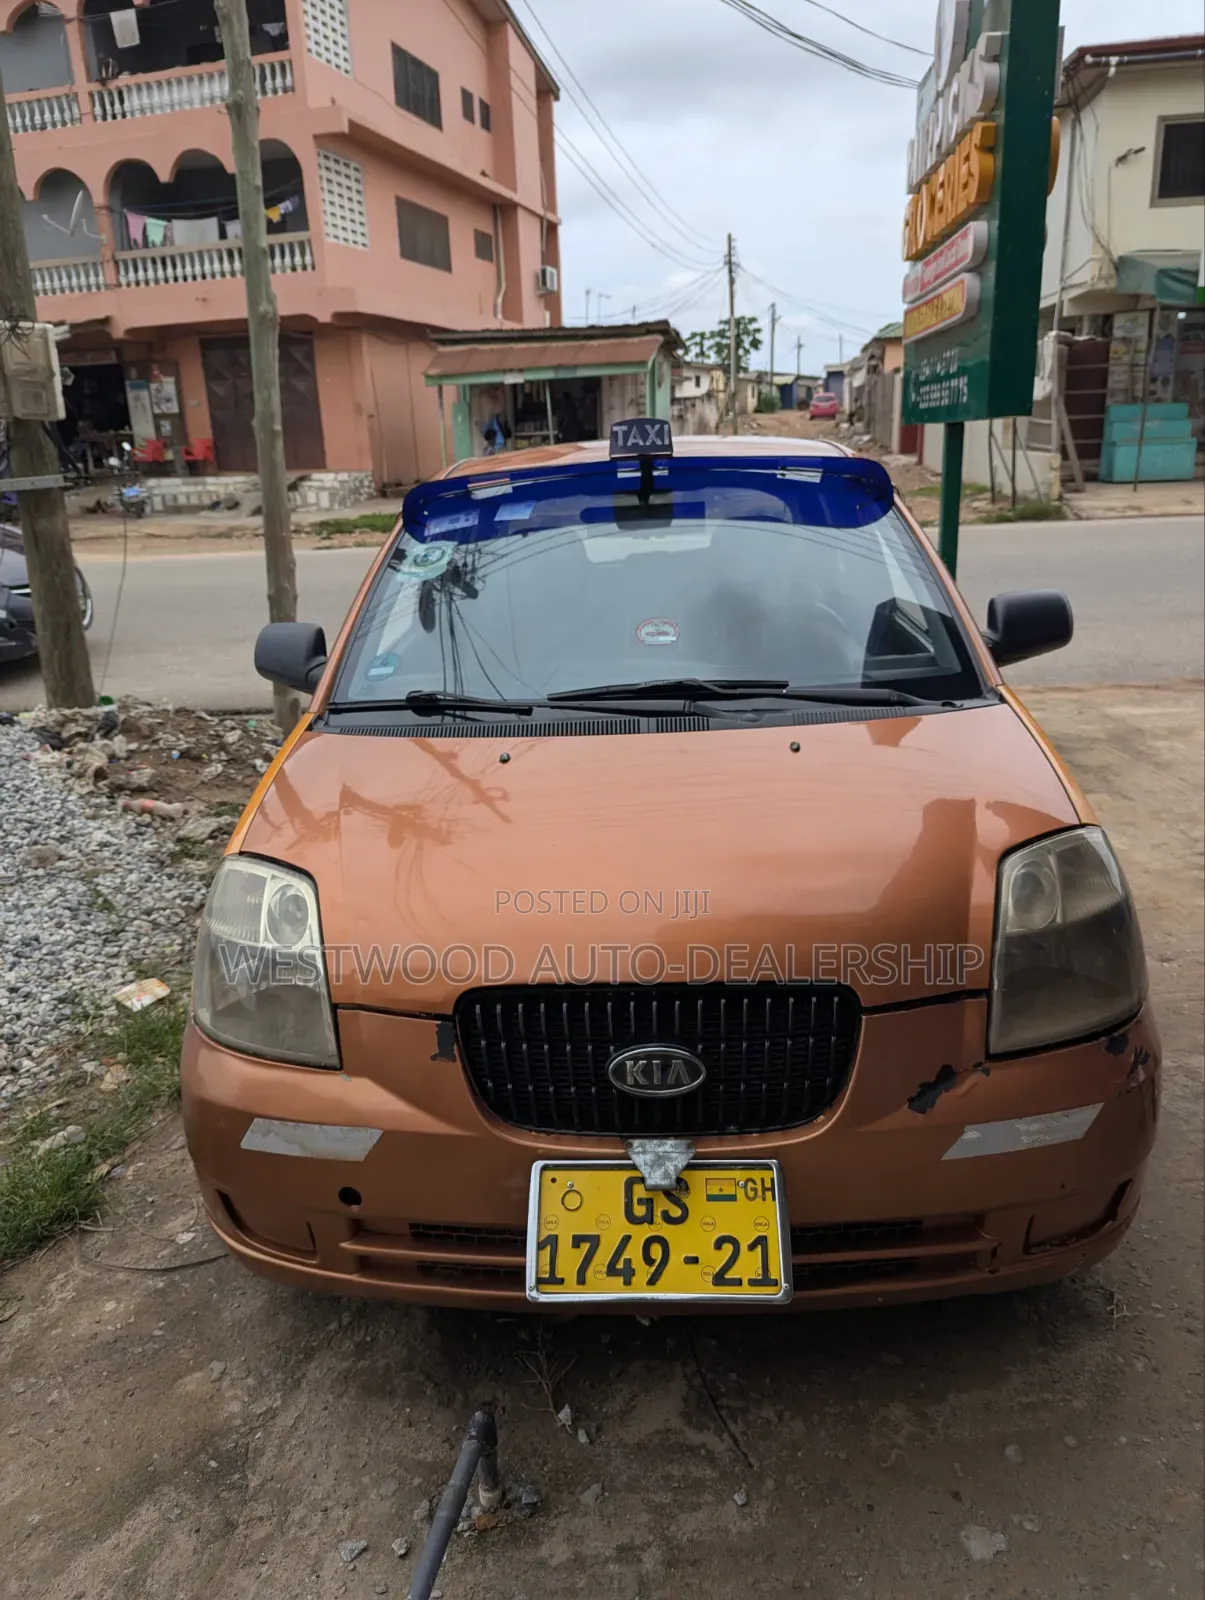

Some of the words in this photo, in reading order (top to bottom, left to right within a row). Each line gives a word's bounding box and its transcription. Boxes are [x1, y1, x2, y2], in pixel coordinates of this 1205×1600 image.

[612, 424, 669, 446] TAXI
[625, 1060, 691, 1085] KIA
[624, 1176, 690, 1226] GS
[743, 1177, 777, 1202] GH
